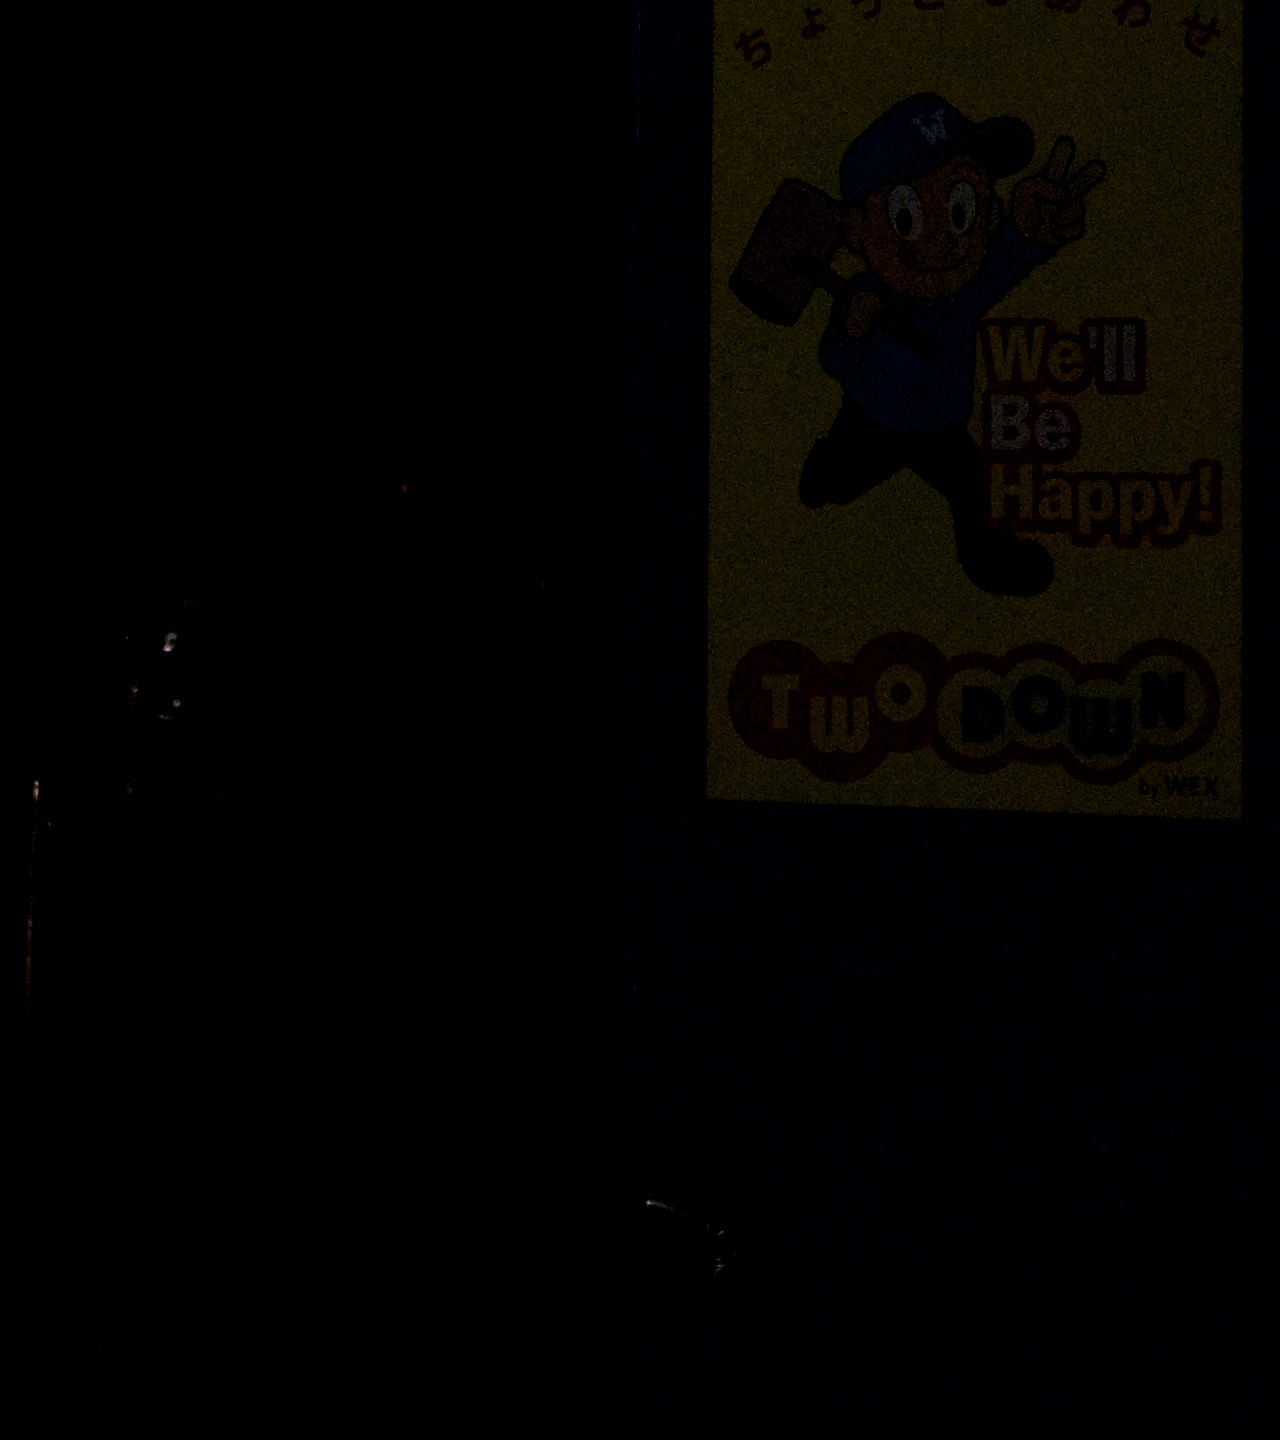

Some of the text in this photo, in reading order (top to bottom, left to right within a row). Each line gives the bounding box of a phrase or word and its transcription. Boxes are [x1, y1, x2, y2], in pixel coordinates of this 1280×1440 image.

[983, 320, 1140, 387] We'll
[986, 391, 1076, 455] Be
[987, 461, 1219, 540] Happy!
[762, 665, 1186, 755] TWO DOWN
[1164, 775, 1219, 797] WEX
